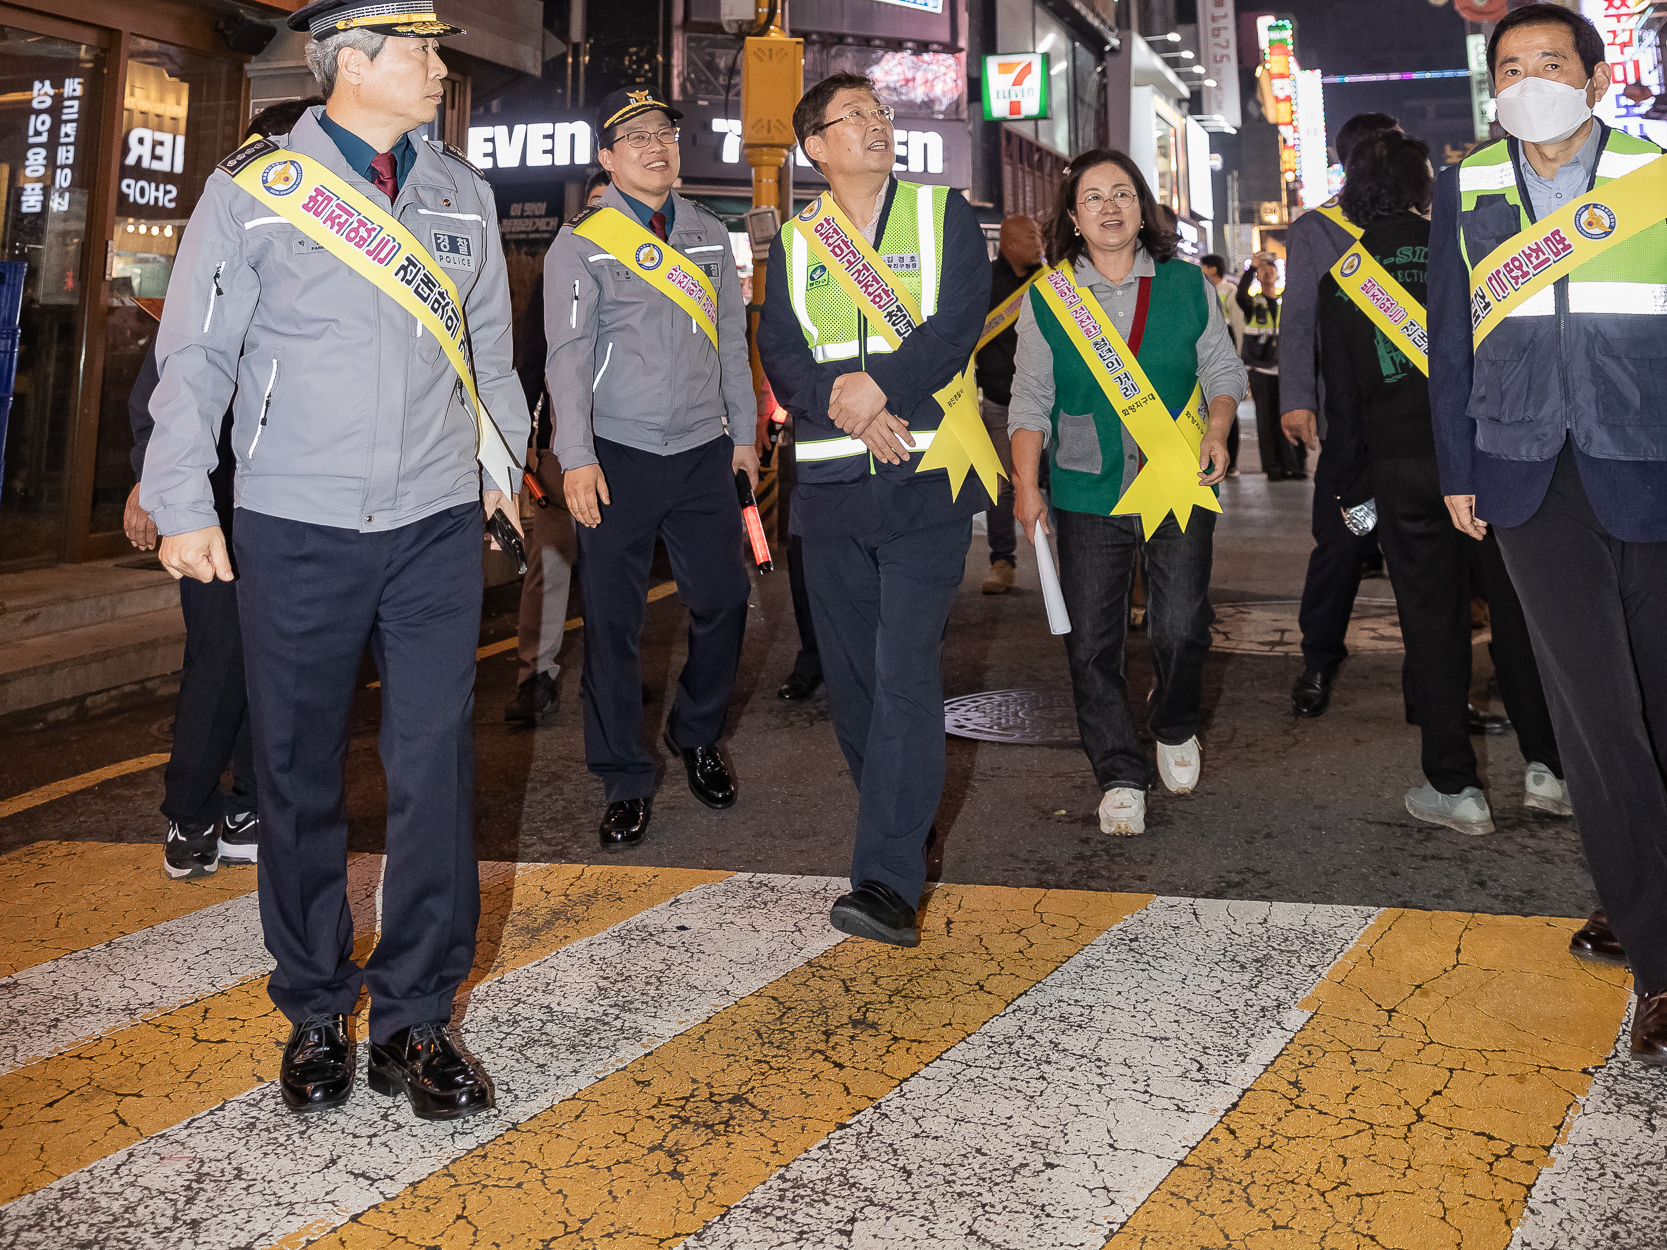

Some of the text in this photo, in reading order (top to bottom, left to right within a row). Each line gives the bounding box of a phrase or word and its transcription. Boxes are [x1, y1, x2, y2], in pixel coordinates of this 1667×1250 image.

[998, 61, 1032, 116] 7
[300, 185, 401, 266] 범죄없는
[437, 234, 469, 255] 경찰
[439, 254, 471, 267] POLICE
[665, 265, 706, 305] 안전하고
[814, 216, 865, 272] 안전하고
[850, 261, 898, 313] 건전한
[1487, 227, 1574, 302] 범죄없는
[1359, 277, 1408, 325] 범죄없는
[1046, 269, 1141, 400] 안전하고 건전한 청년의 거리
[1121, 392, 1157, 417] 화양지구대
